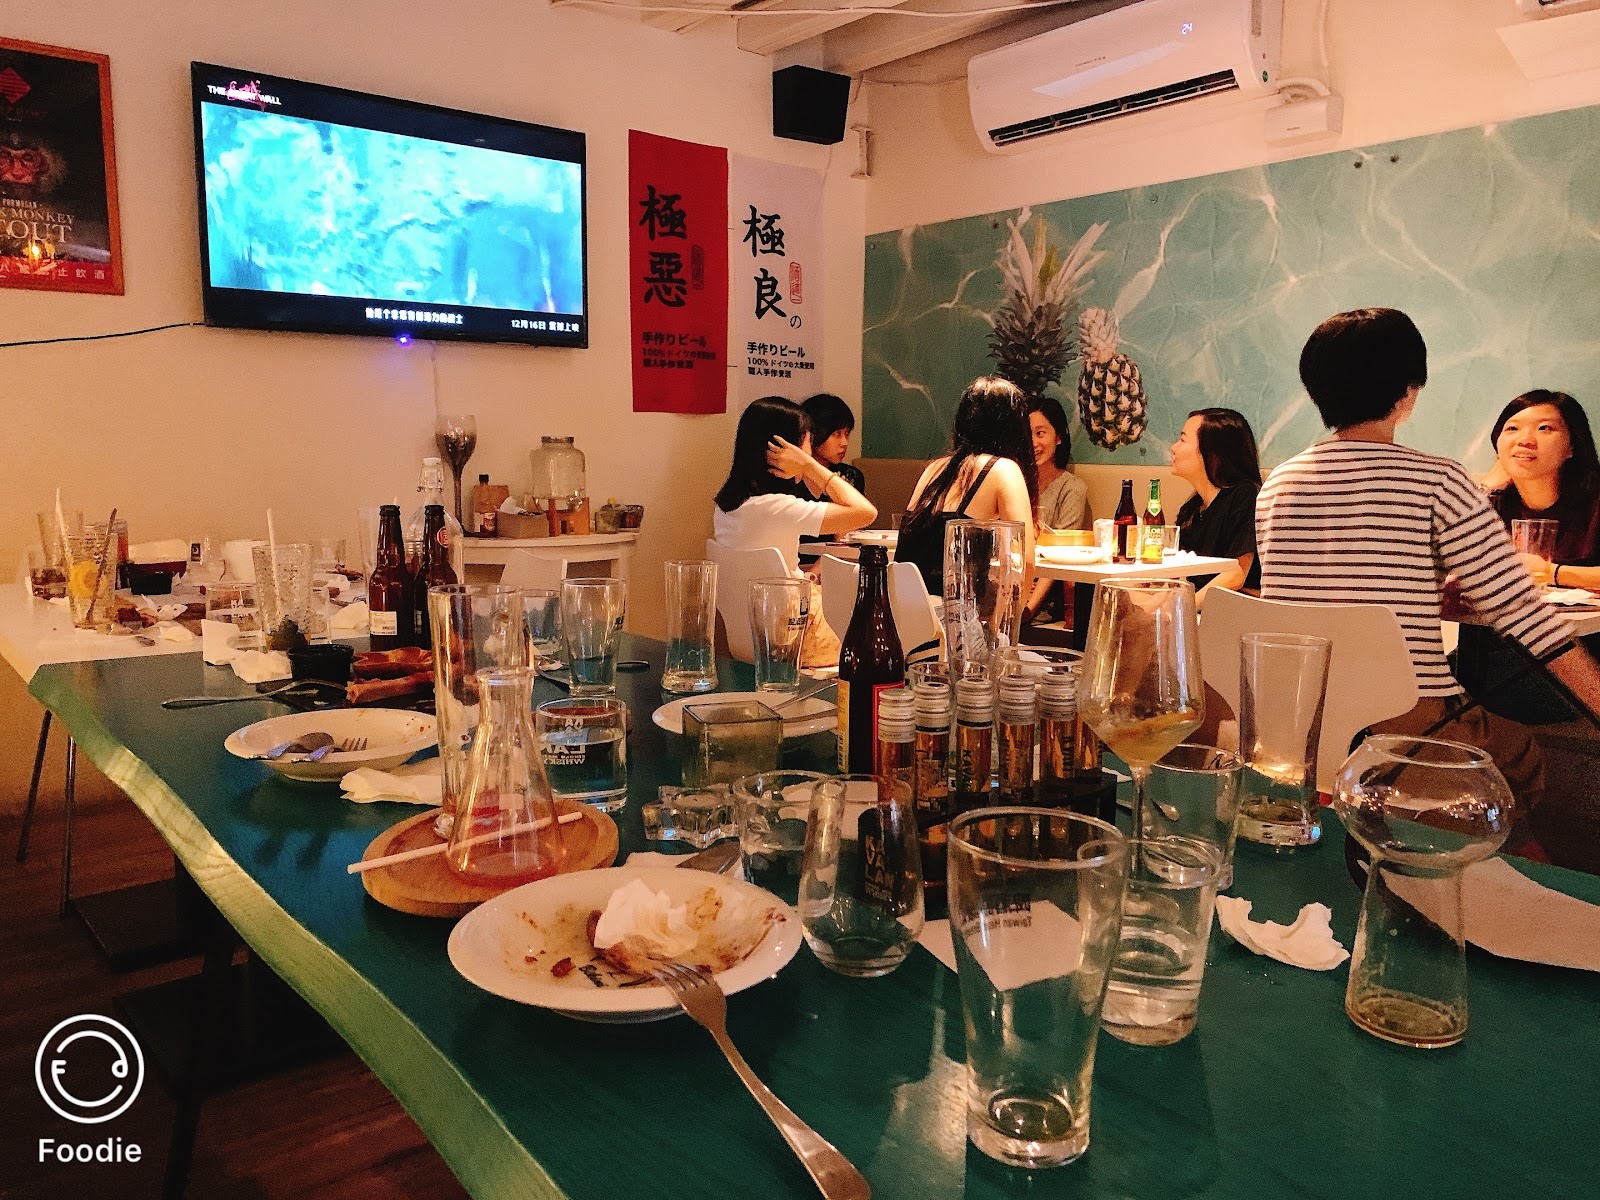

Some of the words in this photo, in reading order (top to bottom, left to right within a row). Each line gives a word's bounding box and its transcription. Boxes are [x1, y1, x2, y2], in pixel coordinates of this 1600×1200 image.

[1181, 22, 1193, 35] 24
[11, 207, 75, 225] MONKEY
[0, 219, 73, 243] OUT
[639, 184, 687, 307] 極惡
[746, 341, 806, 358] 手作りビール
